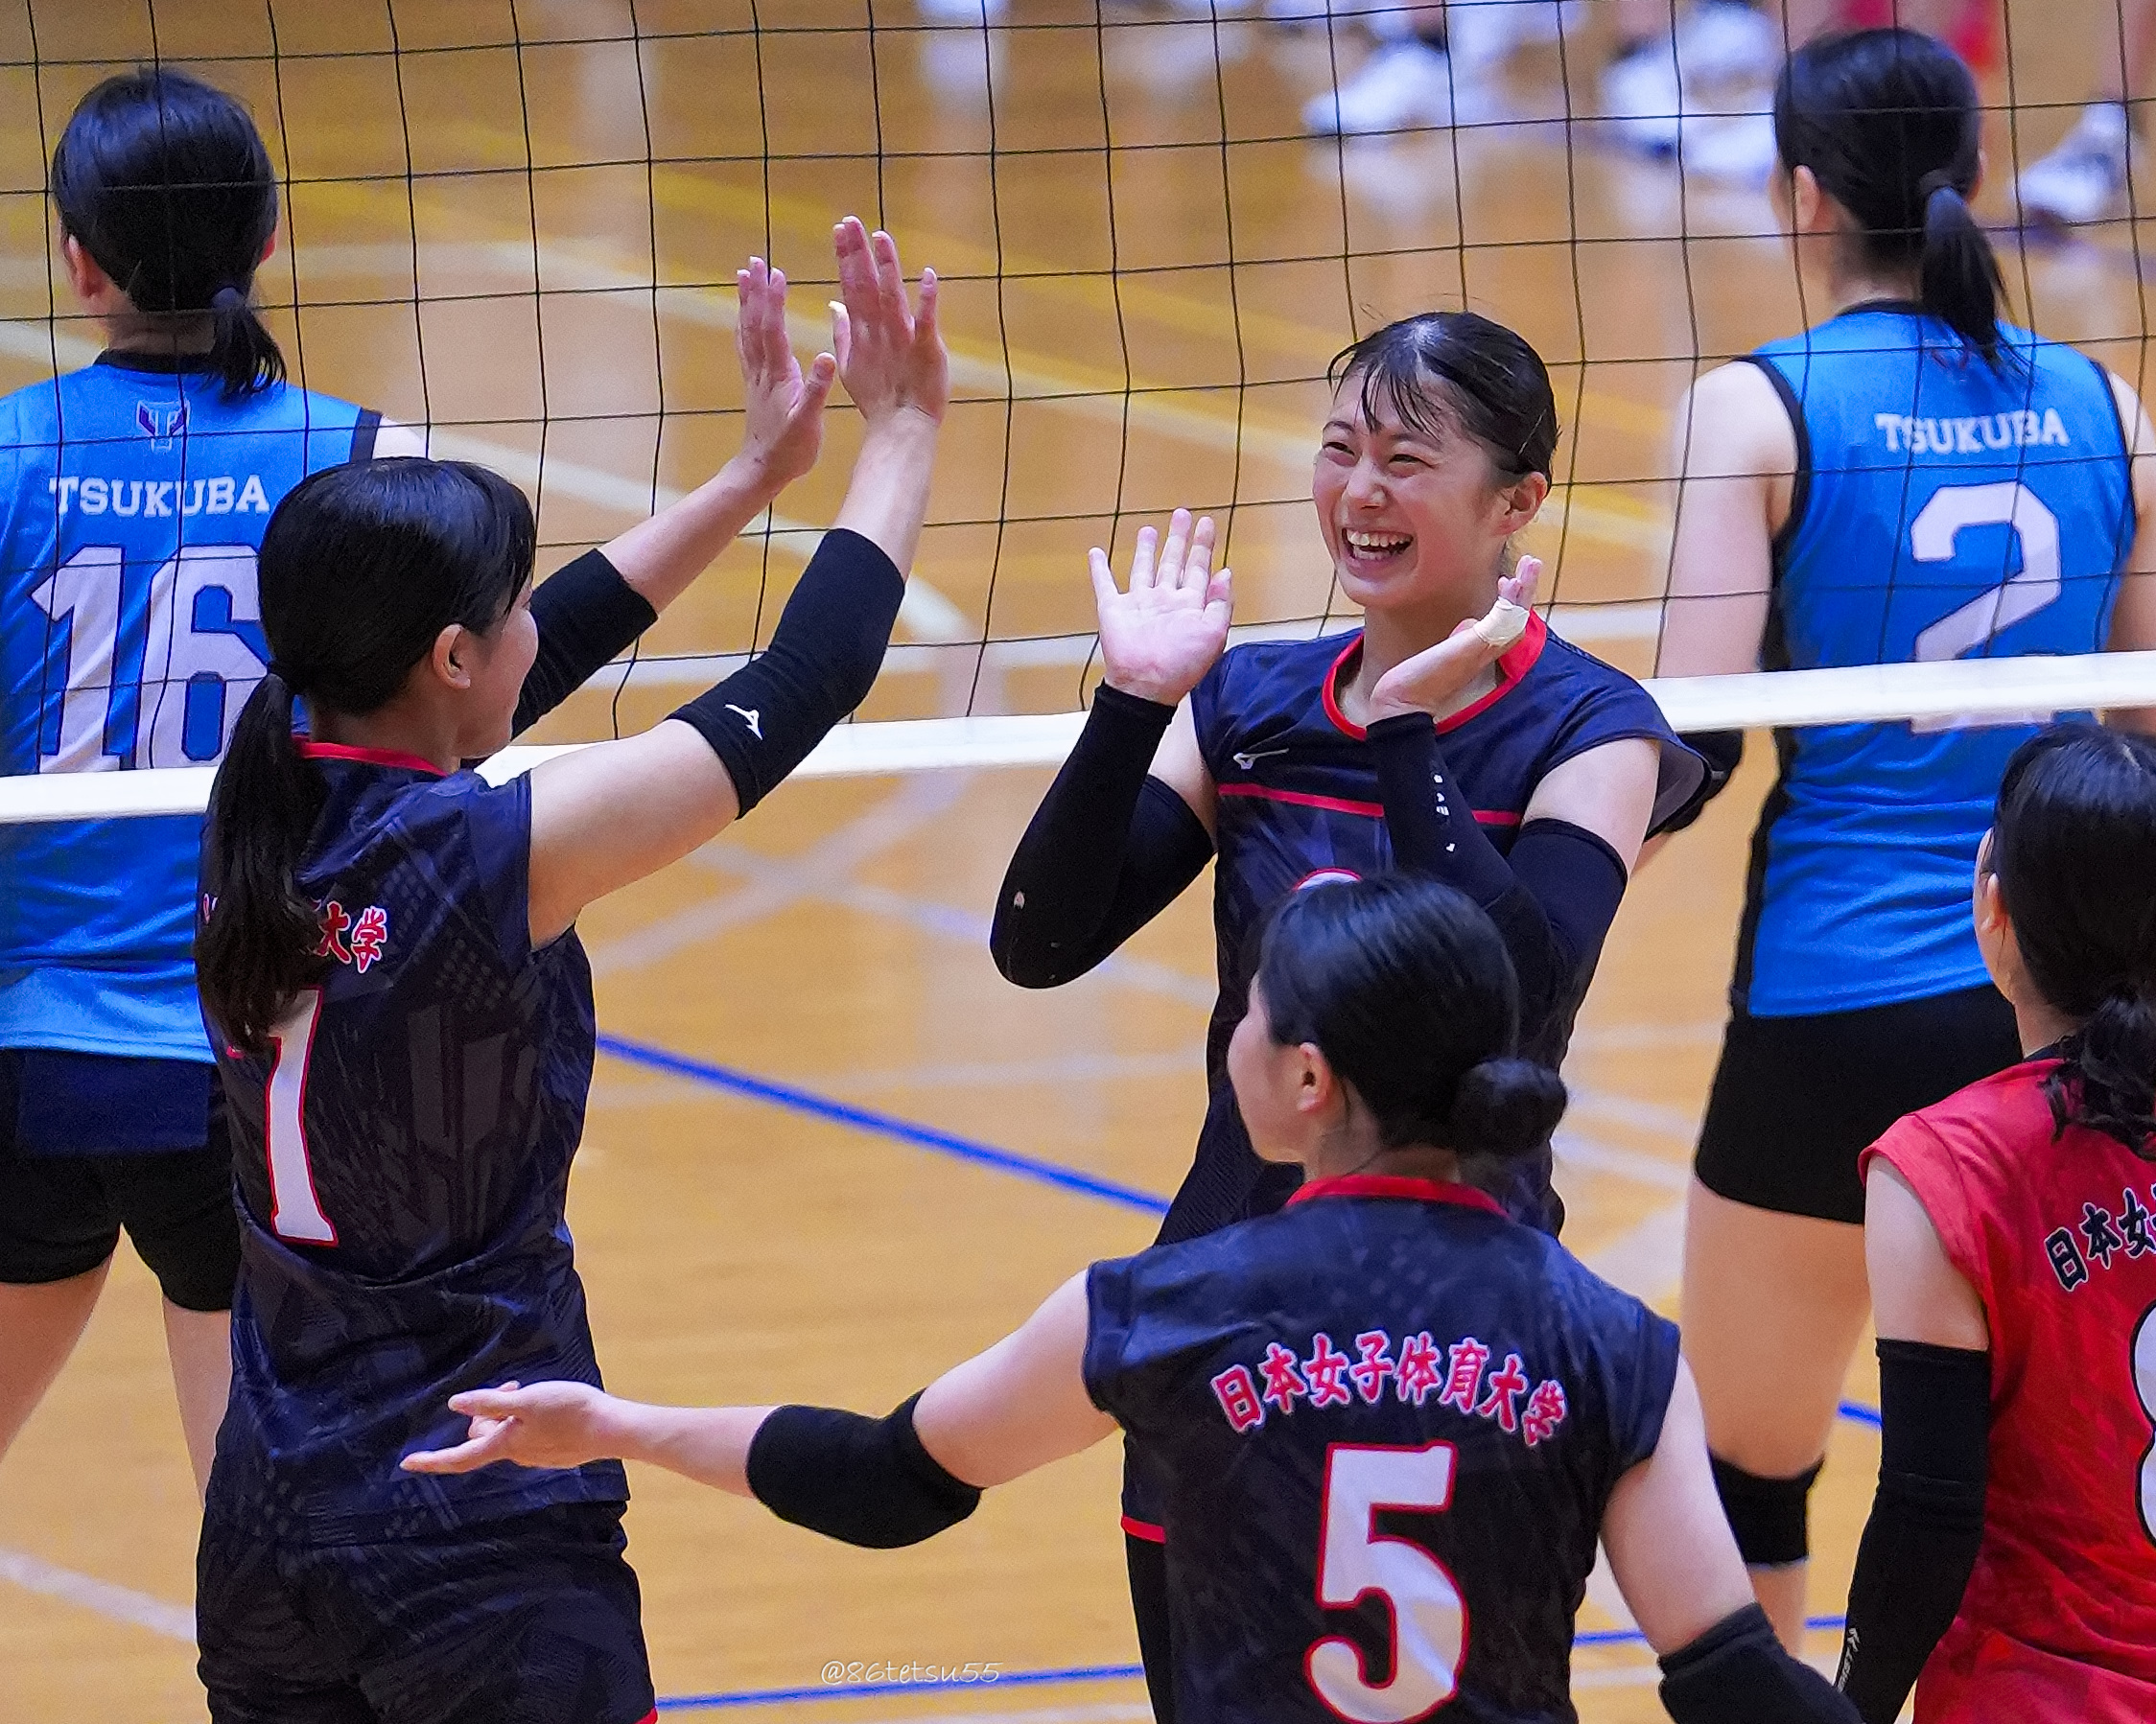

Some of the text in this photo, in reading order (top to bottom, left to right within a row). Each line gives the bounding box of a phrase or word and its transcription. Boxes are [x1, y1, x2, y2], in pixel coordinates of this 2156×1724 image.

[1874, 408, 2071, 454] TSUKUBA
[48, 475, 270, 517] TSUKUBA
[28, 543, 270, 774] 16
[1910, 480, 2062, 734] 2
[313, 899, 387, 973] 大学
[2044, 1182, 2156, 1293] 日本女
[1210, 1329, 1566, 1447] 日本女子体育大学
[1302, 1439, 1470, 1724] 5
